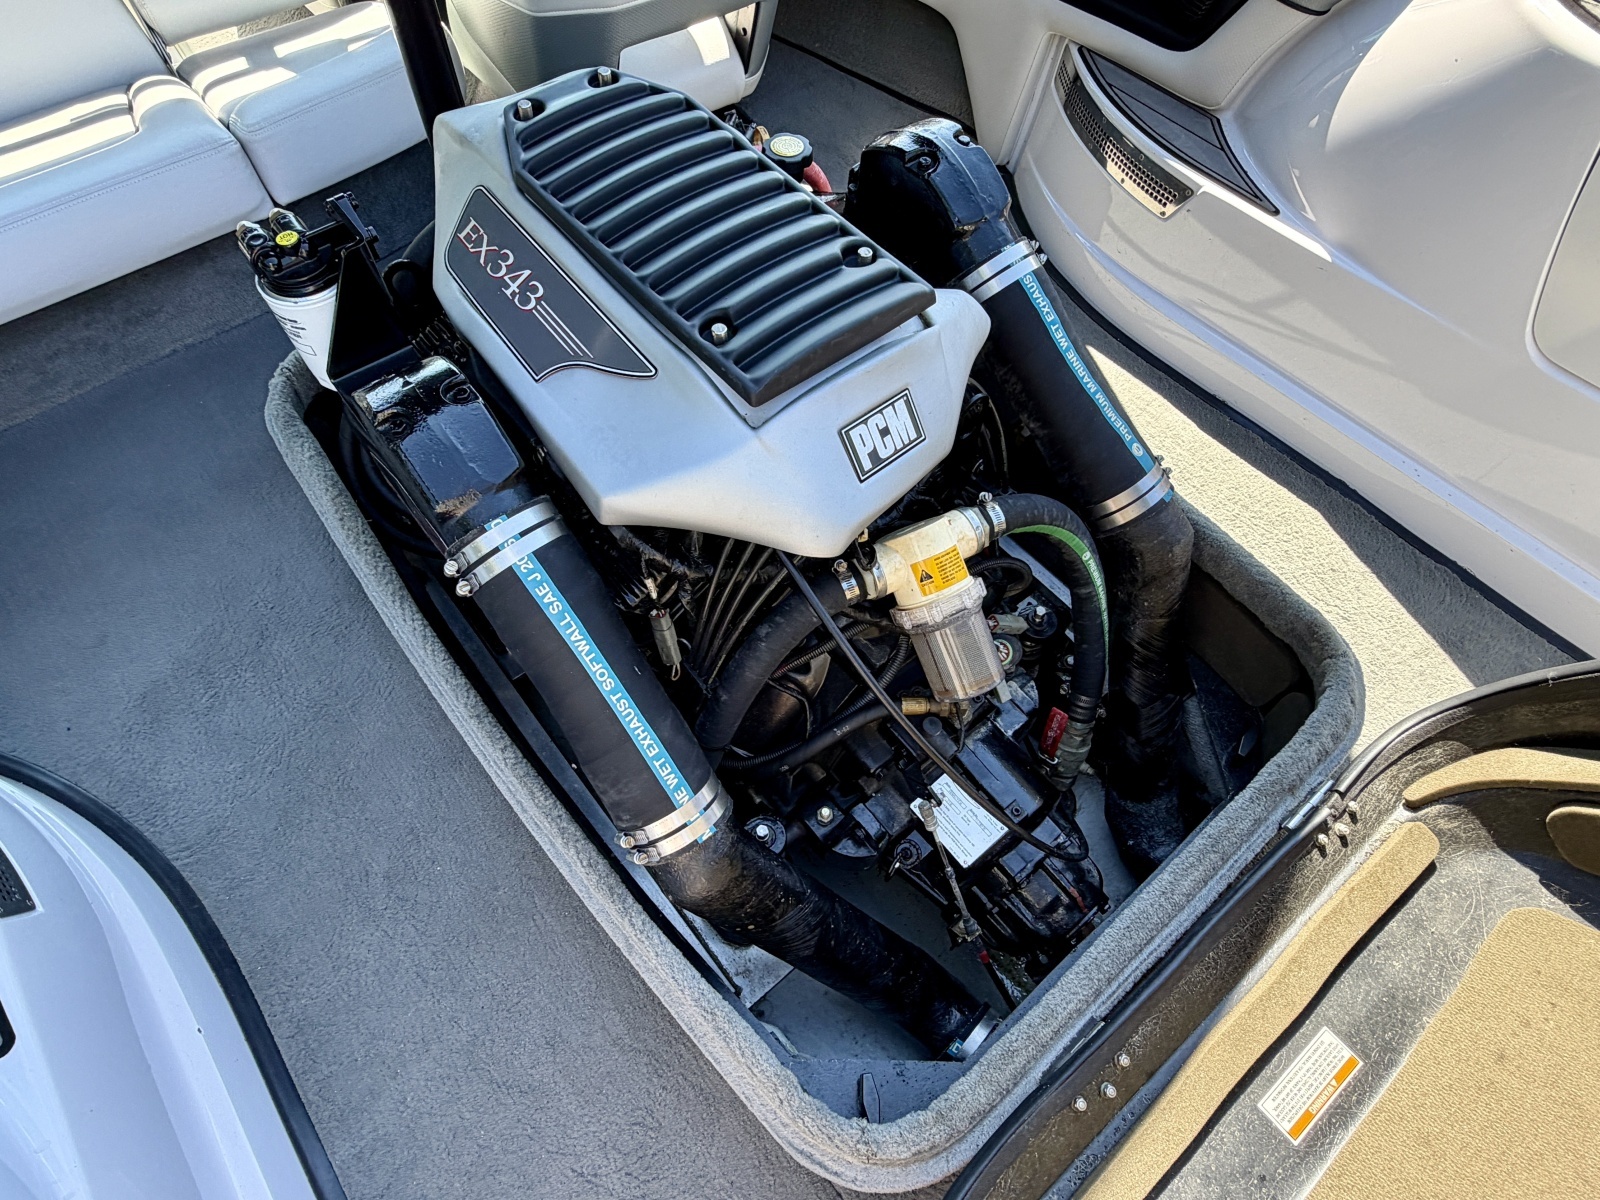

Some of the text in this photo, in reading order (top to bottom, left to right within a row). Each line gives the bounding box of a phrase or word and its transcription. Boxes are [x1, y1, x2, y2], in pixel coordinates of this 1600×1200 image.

[457, 216, 544, 311] EX343
[1021, 274, 1132, 441] PREMIUM MARINE WET EXHAUS
[849, 398, 917, 472] PCM
[526, 572, 542, 581] J
[535, 582, 563, 615] SAE
[560, 612, 615, 691] SOFTWALL
[610, 692, 660, 758] EXHAUST
[653, 757, 679, 790] WET
[1308, 1080, 1335, 1115] WARNING
